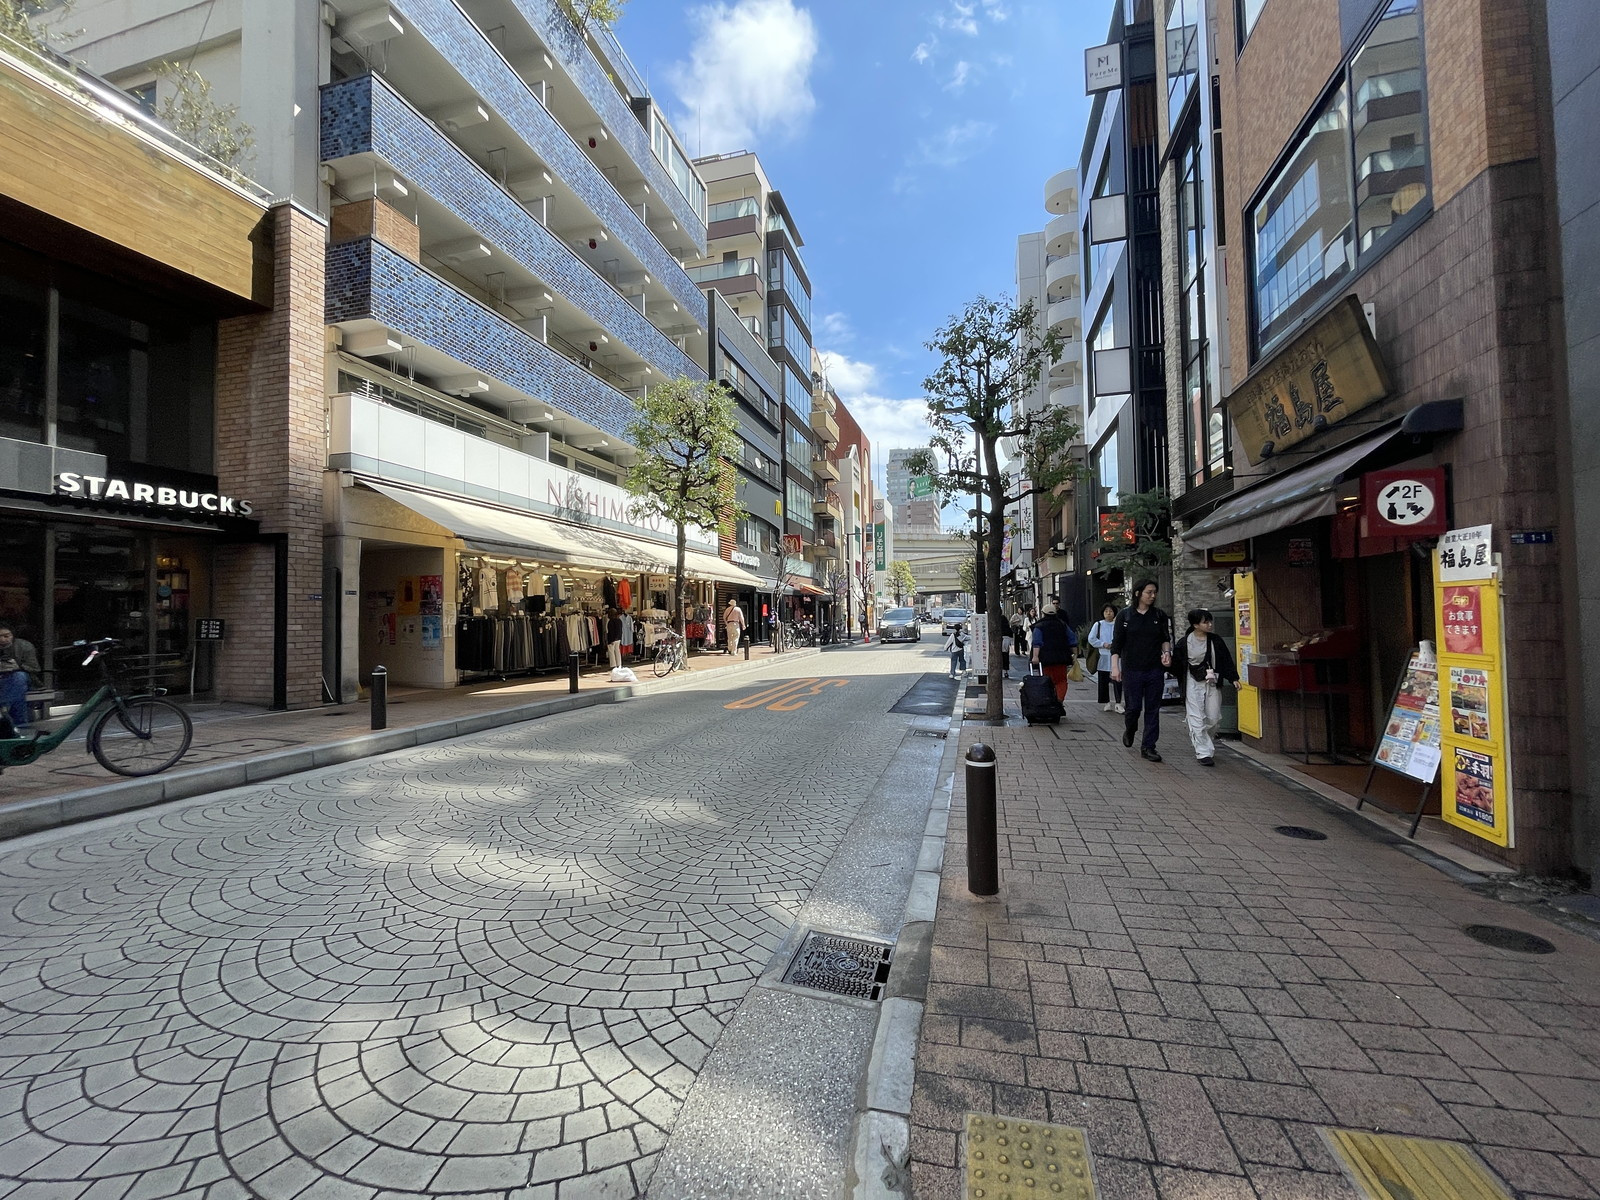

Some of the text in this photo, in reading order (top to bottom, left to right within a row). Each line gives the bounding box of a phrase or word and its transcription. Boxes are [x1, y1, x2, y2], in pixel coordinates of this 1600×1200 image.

[1264, 359, 1344, 439] 福島屋
[57, 472, 254, 516] STARBUCKS
[1402, 485, 1423, 499] 2F
[1440, 543, 1487, 569] 福島屋
[1448, 610, 1474, 621] お食事
[1445, 624, 1478, 635] できます
